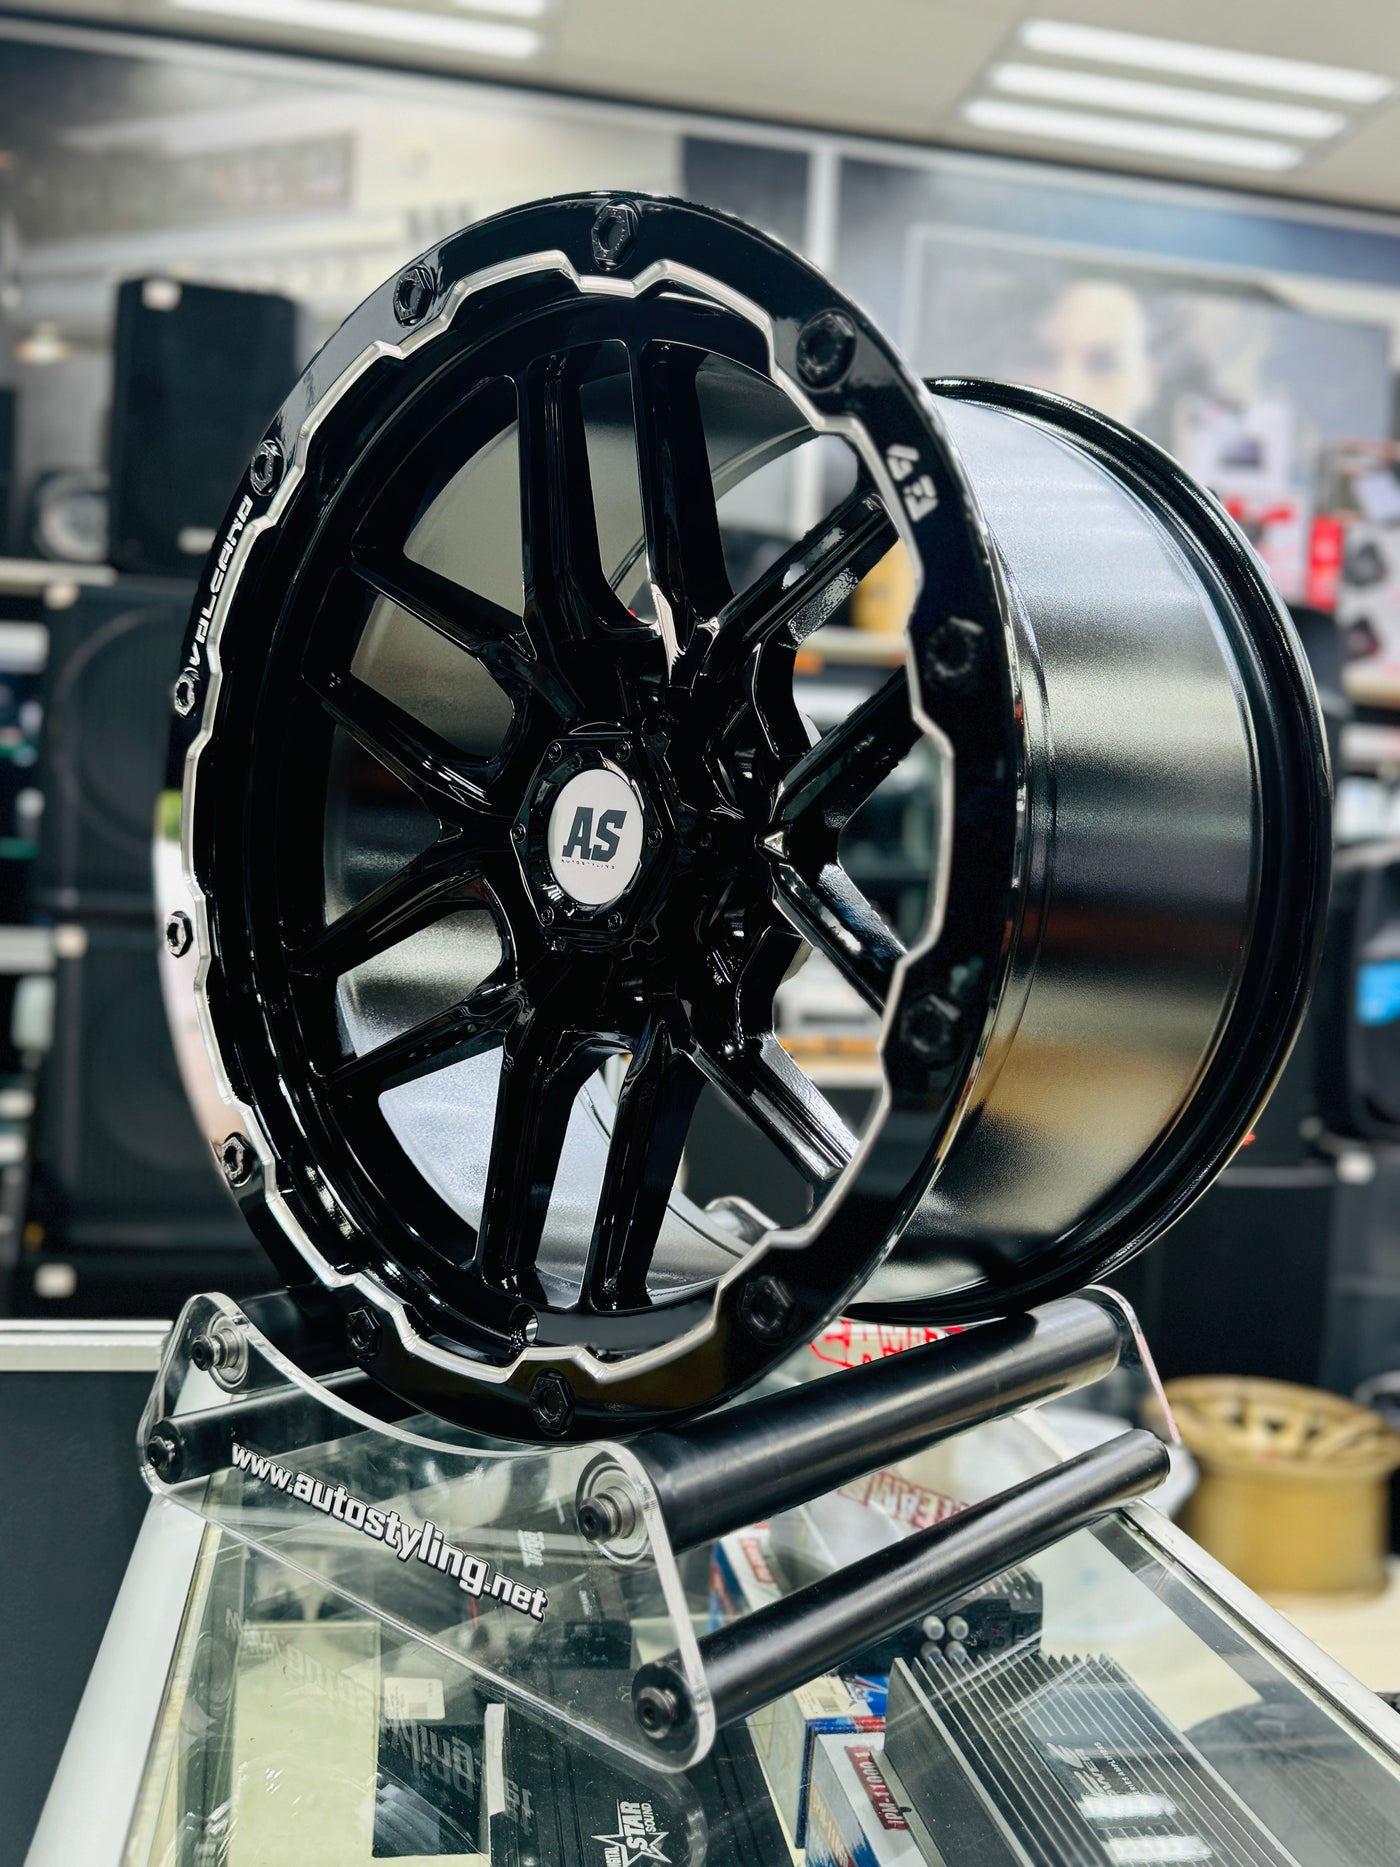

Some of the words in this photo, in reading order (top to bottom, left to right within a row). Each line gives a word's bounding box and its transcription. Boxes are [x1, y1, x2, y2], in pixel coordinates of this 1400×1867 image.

[562, 806, 627, 862] AS
[232, 1442, 549, 1622] www.autostyling.net
[620, 1801, 648, 1851] STAR
[641, 1802, 656, 1832] SOUND
[604, 1845, 622, 1867] IGITAL
